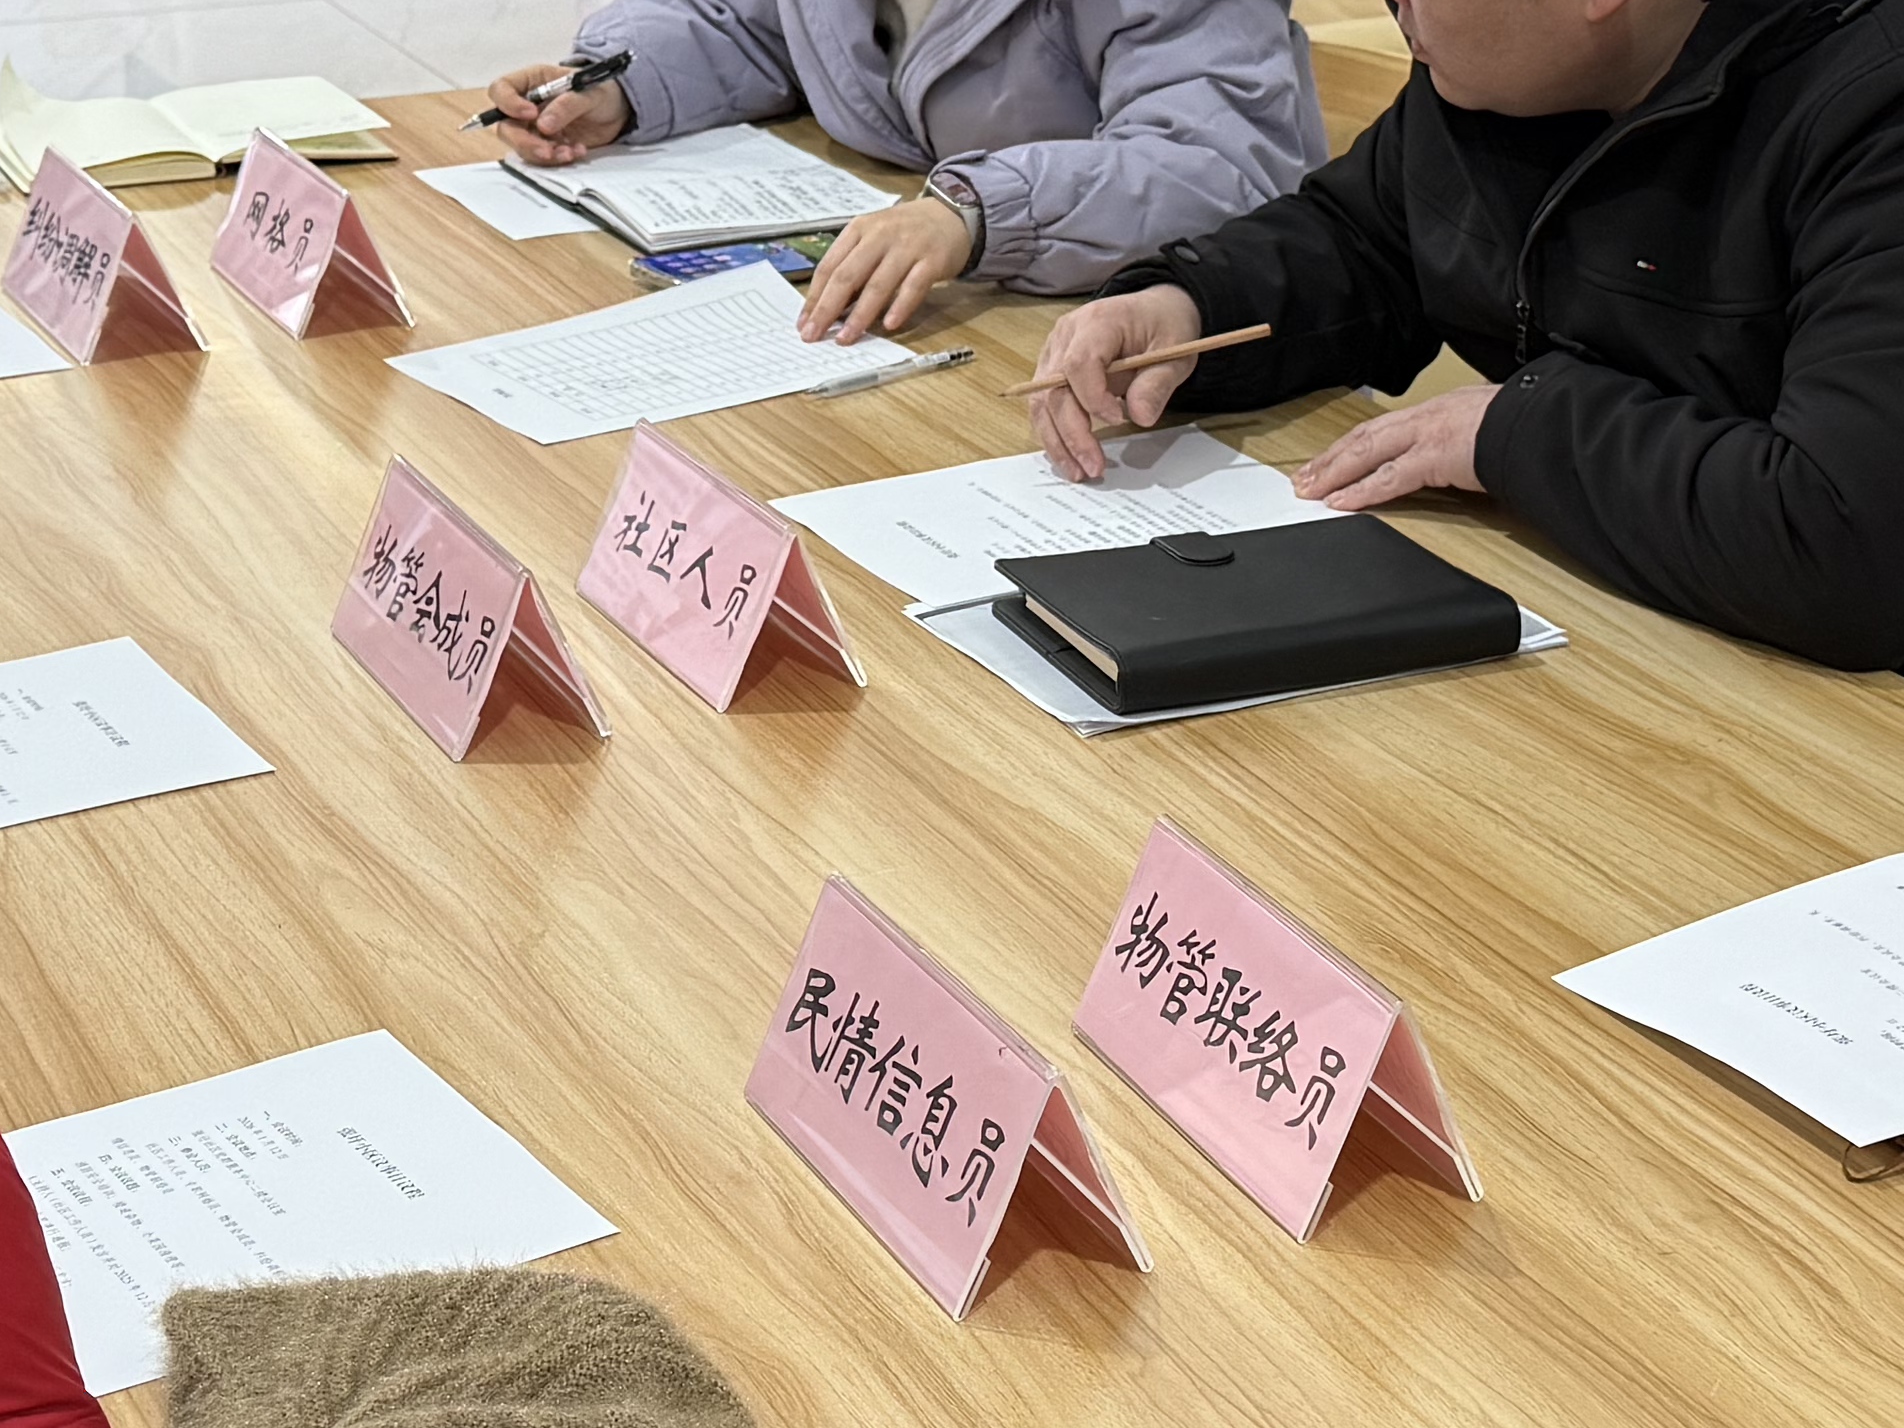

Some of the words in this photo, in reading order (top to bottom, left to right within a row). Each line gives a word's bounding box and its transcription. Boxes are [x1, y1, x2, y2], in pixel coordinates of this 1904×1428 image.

[23, 197, 111, 311] 纠纷调解员
[243, 190, 315, 270] 网格员
[362, 524, 499, 697] 物管会成员
[613, 491, 757, 640] 社区人员
[785, 967, 1007, 1228] 民情信息员
[1115, 891, 1348, 1151] 物管联络员
